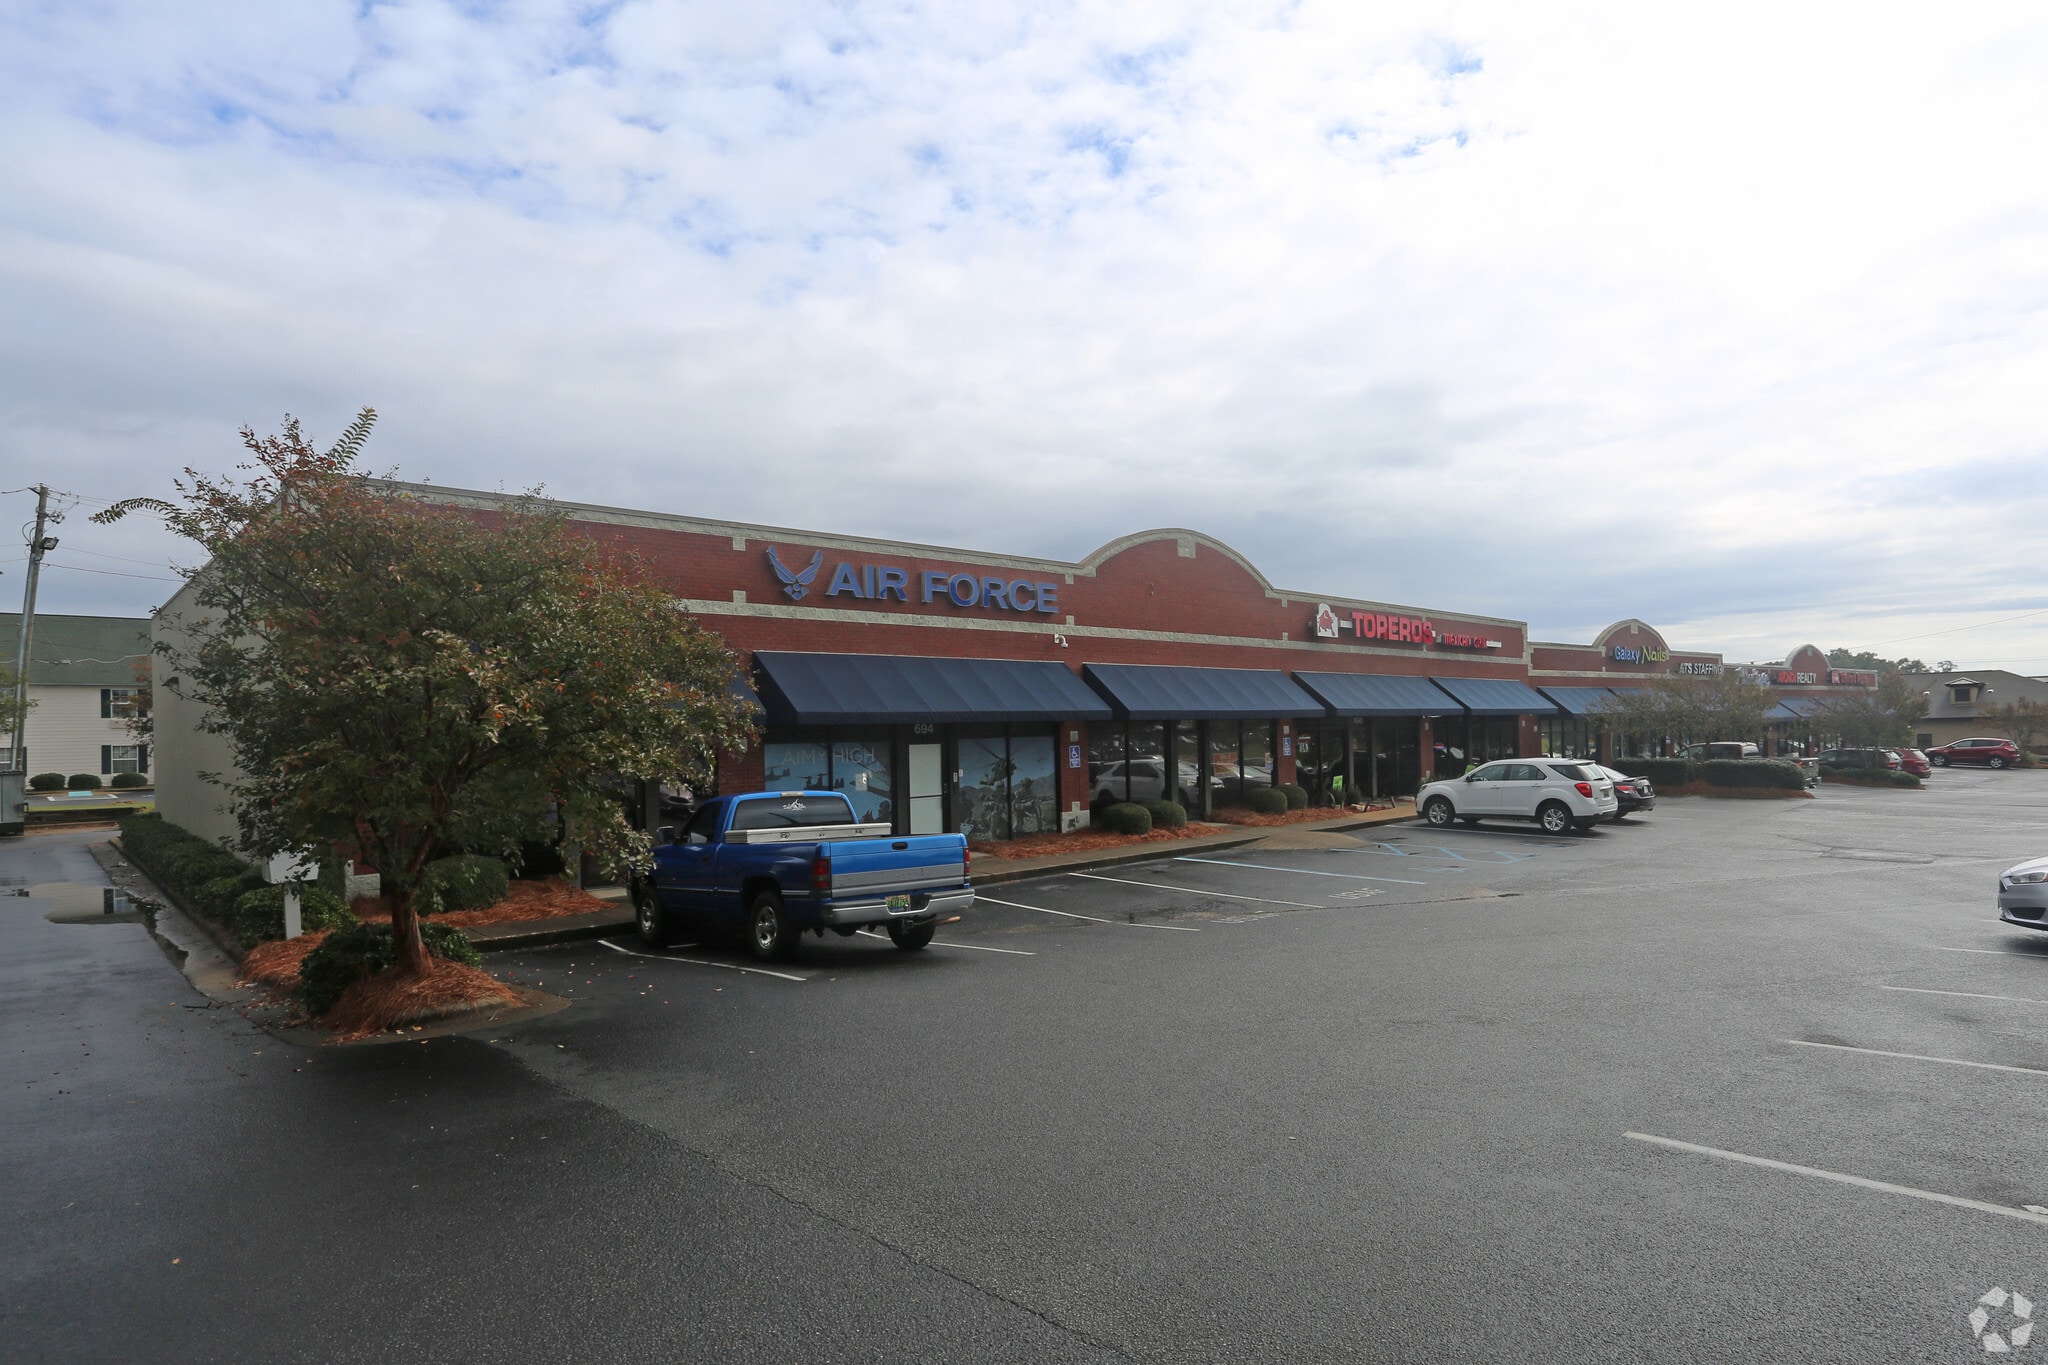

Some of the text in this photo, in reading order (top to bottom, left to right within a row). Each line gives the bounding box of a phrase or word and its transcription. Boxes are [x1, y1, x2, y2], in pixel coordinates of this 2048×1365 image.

[827, 561, 1060, 614] AIR FORCE
[1351, 611, 1434, 645] TOREROS
[1614, 645, 1668, 664] Galaxy Nails
[1797, 671, 1817, 684] REALTY
[914, 723, 934, 734] 694
[782, 746, 875, 765] AIM HIGH
